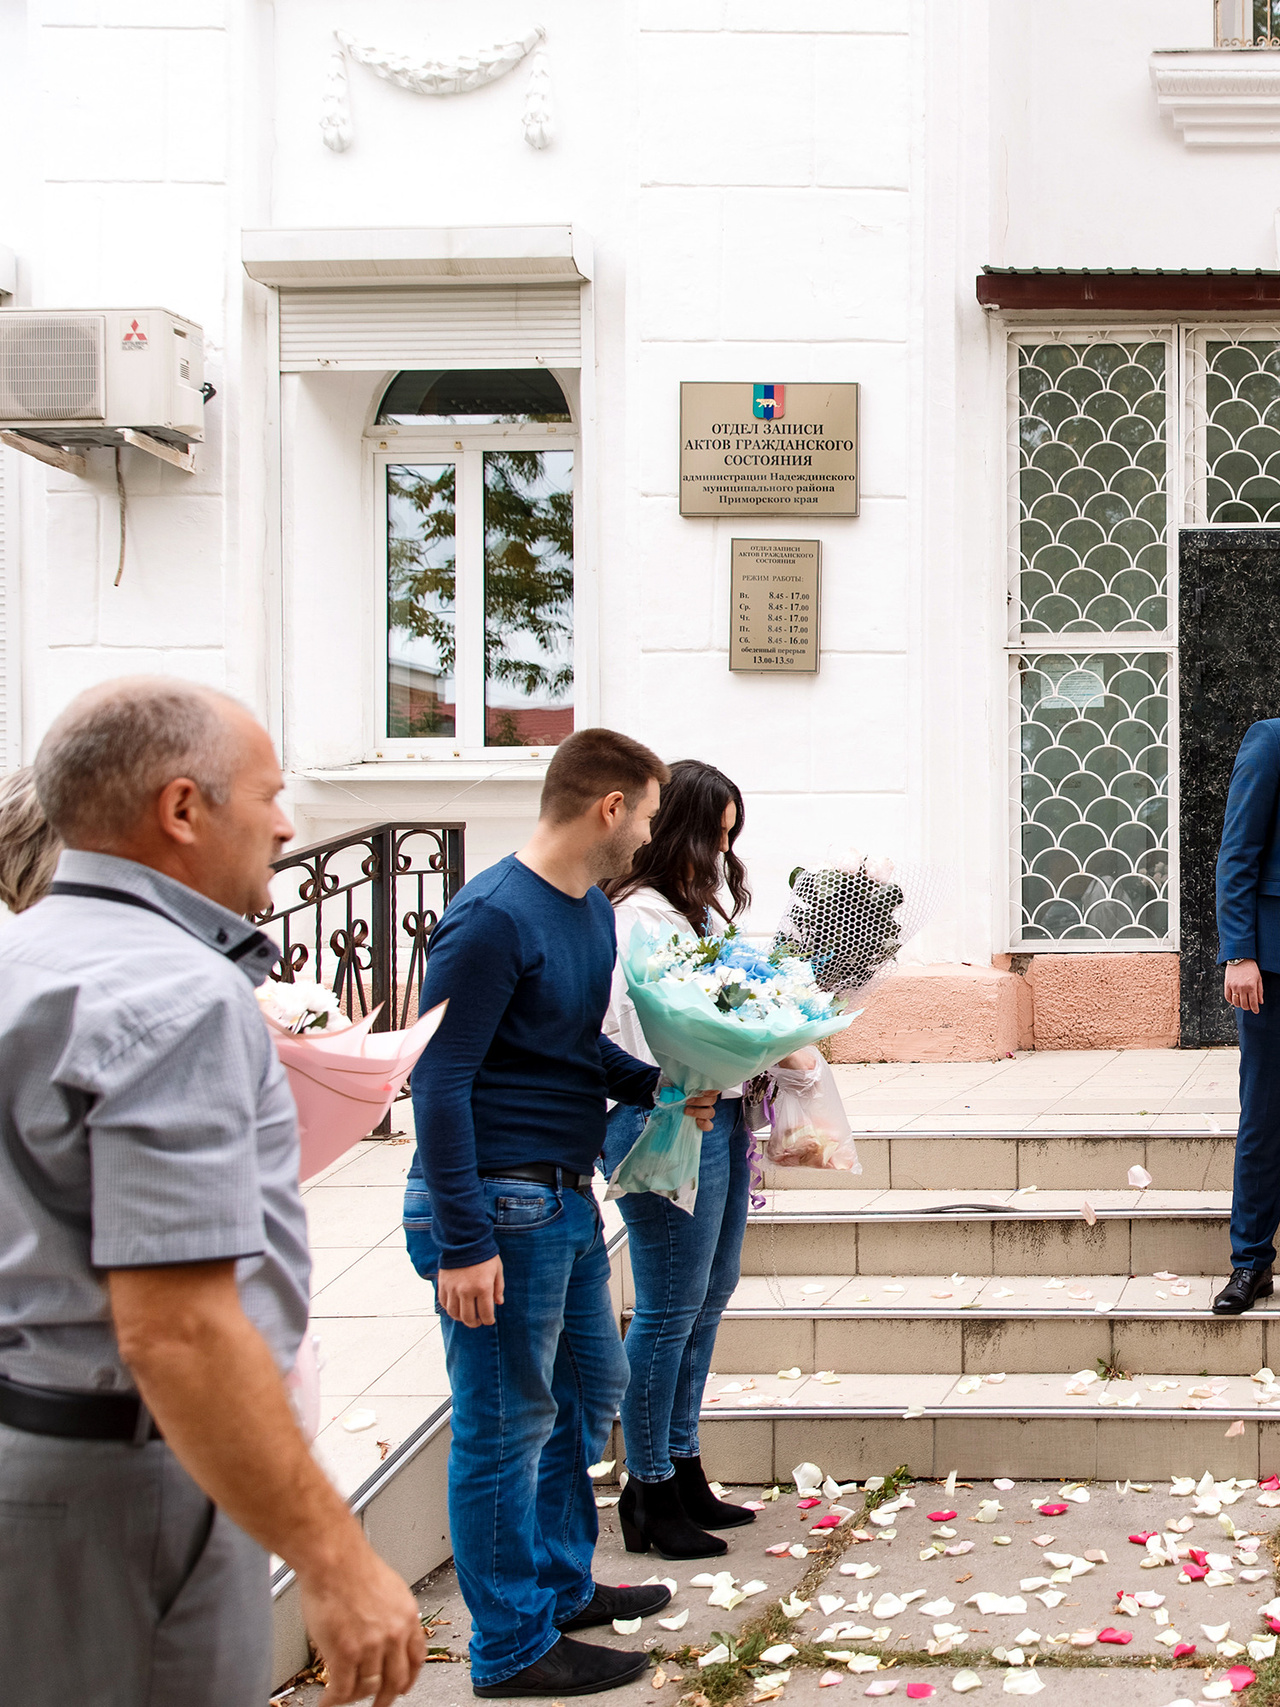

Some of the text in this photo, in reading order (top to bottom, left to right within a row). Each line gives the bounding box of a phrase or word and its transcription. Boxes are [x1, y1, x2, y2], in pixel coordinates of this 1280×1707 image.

[712, 423, 823, 435] ОТДЕЛ ЗАПИСИ
[684, 439, 853, 452] АКТОВ ГРАЖДАНСКОГО
[724, 455, 812, 466] СОСТОЯНИЯ
[683, 473, 855, 483] администрации Надеждинского
[702, 484, 835, 494] муниципального района
[719, 496, 791, 505] Приморского
